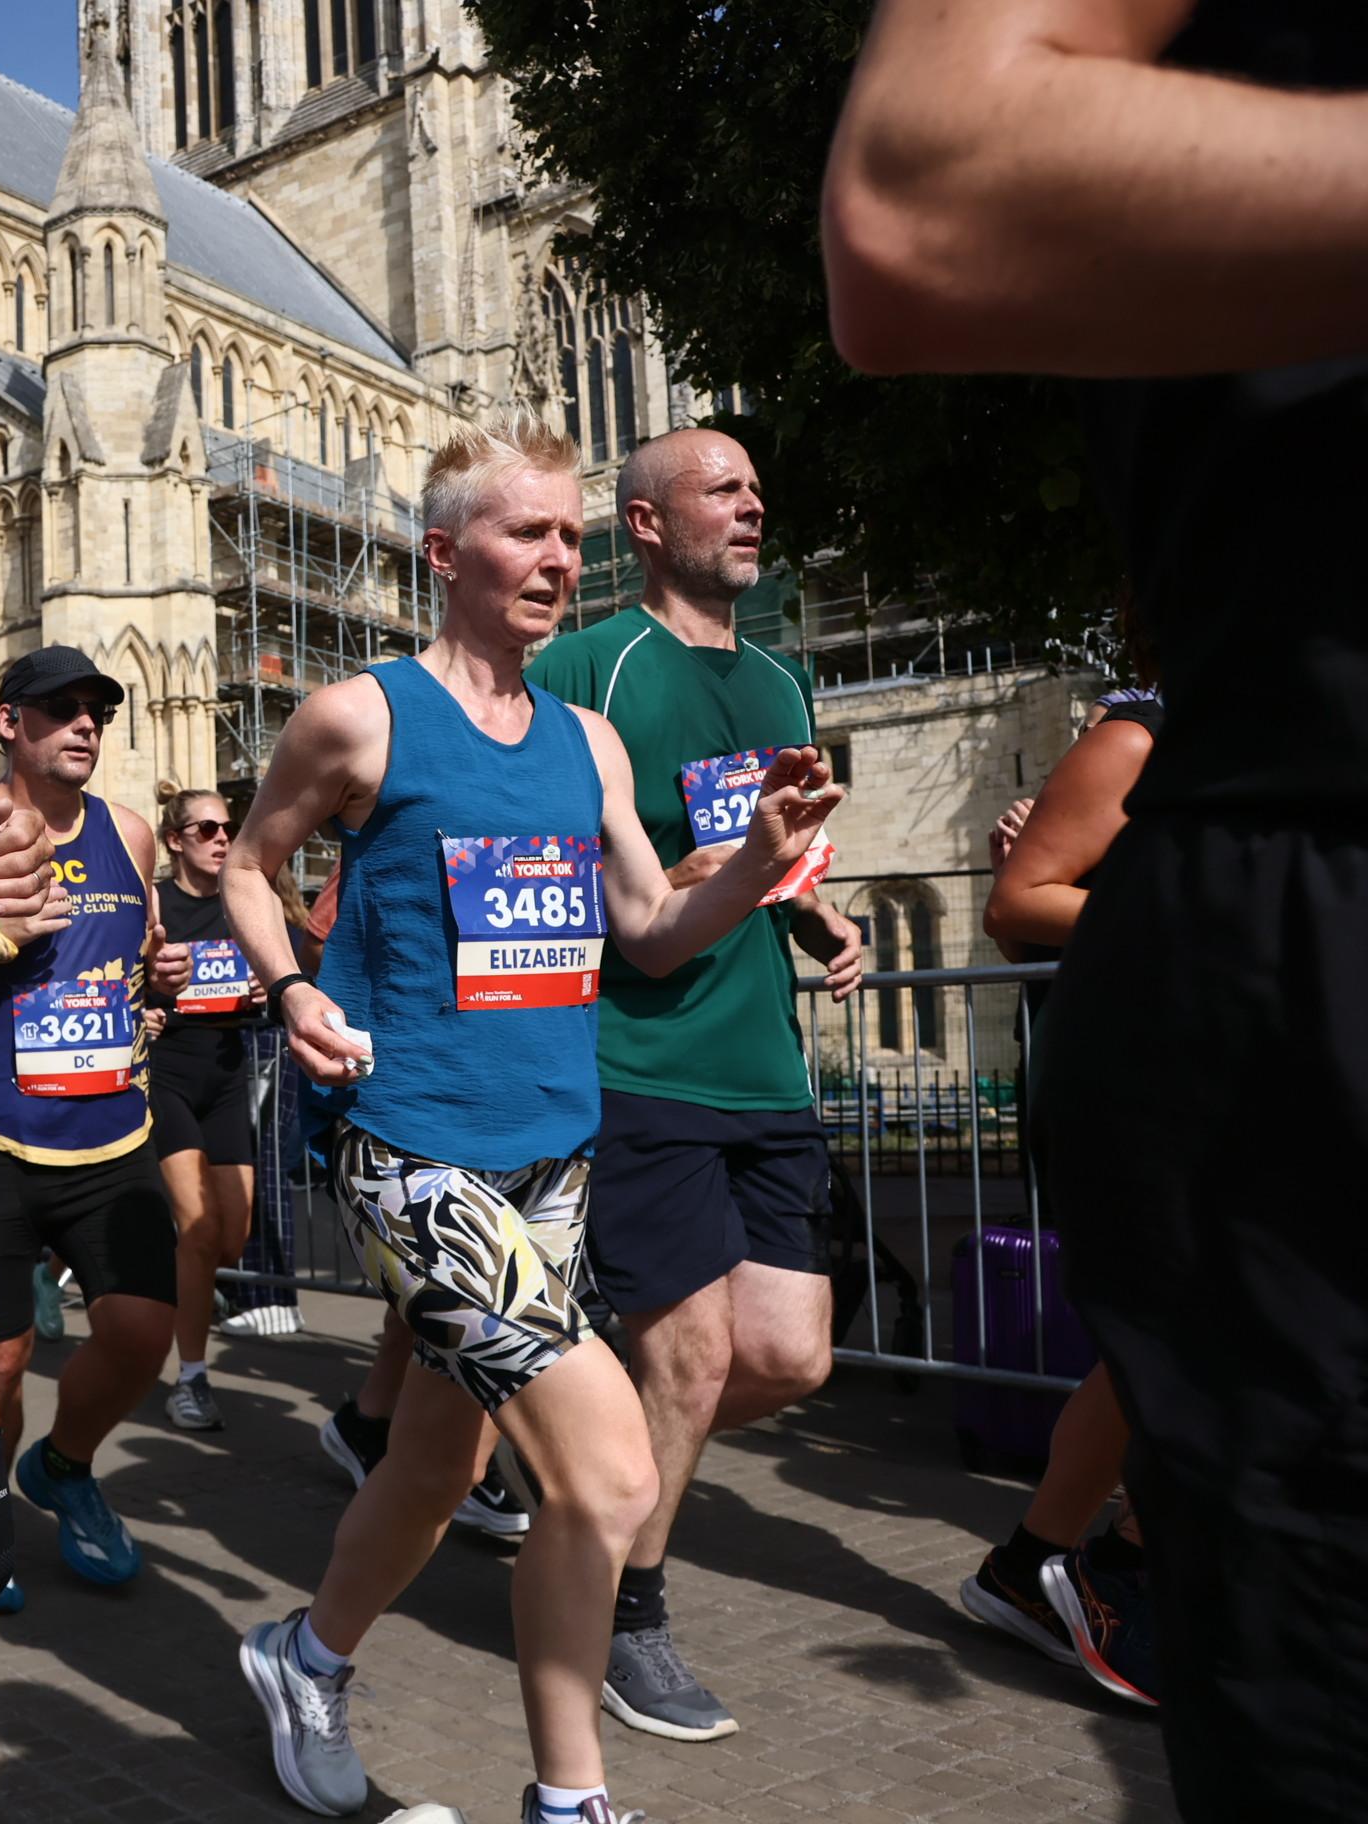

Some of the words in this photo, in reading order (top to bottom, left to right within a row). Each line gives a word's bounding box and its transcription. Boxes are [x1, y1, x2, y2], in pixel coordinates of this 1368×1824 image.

[726, 772, 754, 788] YORK
[752, 769, 766, 781] 10
[514, 863, 552, 877] YORK
[552, 862, 573, 875] 10K
[85, 893, 119, 903] UPON
[120, 894, 144, 906] HULL
[483, 885, 586, 929] 3485
[83, 903, 117, 914] CLUB
[490, 946, 587, 970] ELIZABETH
[197, 960, 237, 981] 604
[194, 986, 241, 997] DUNCAN
[65, 998, 92, 1008] YORK
[39, 1012, 114, 1044] 3621
[73, 1055, 95, 1069] DC
